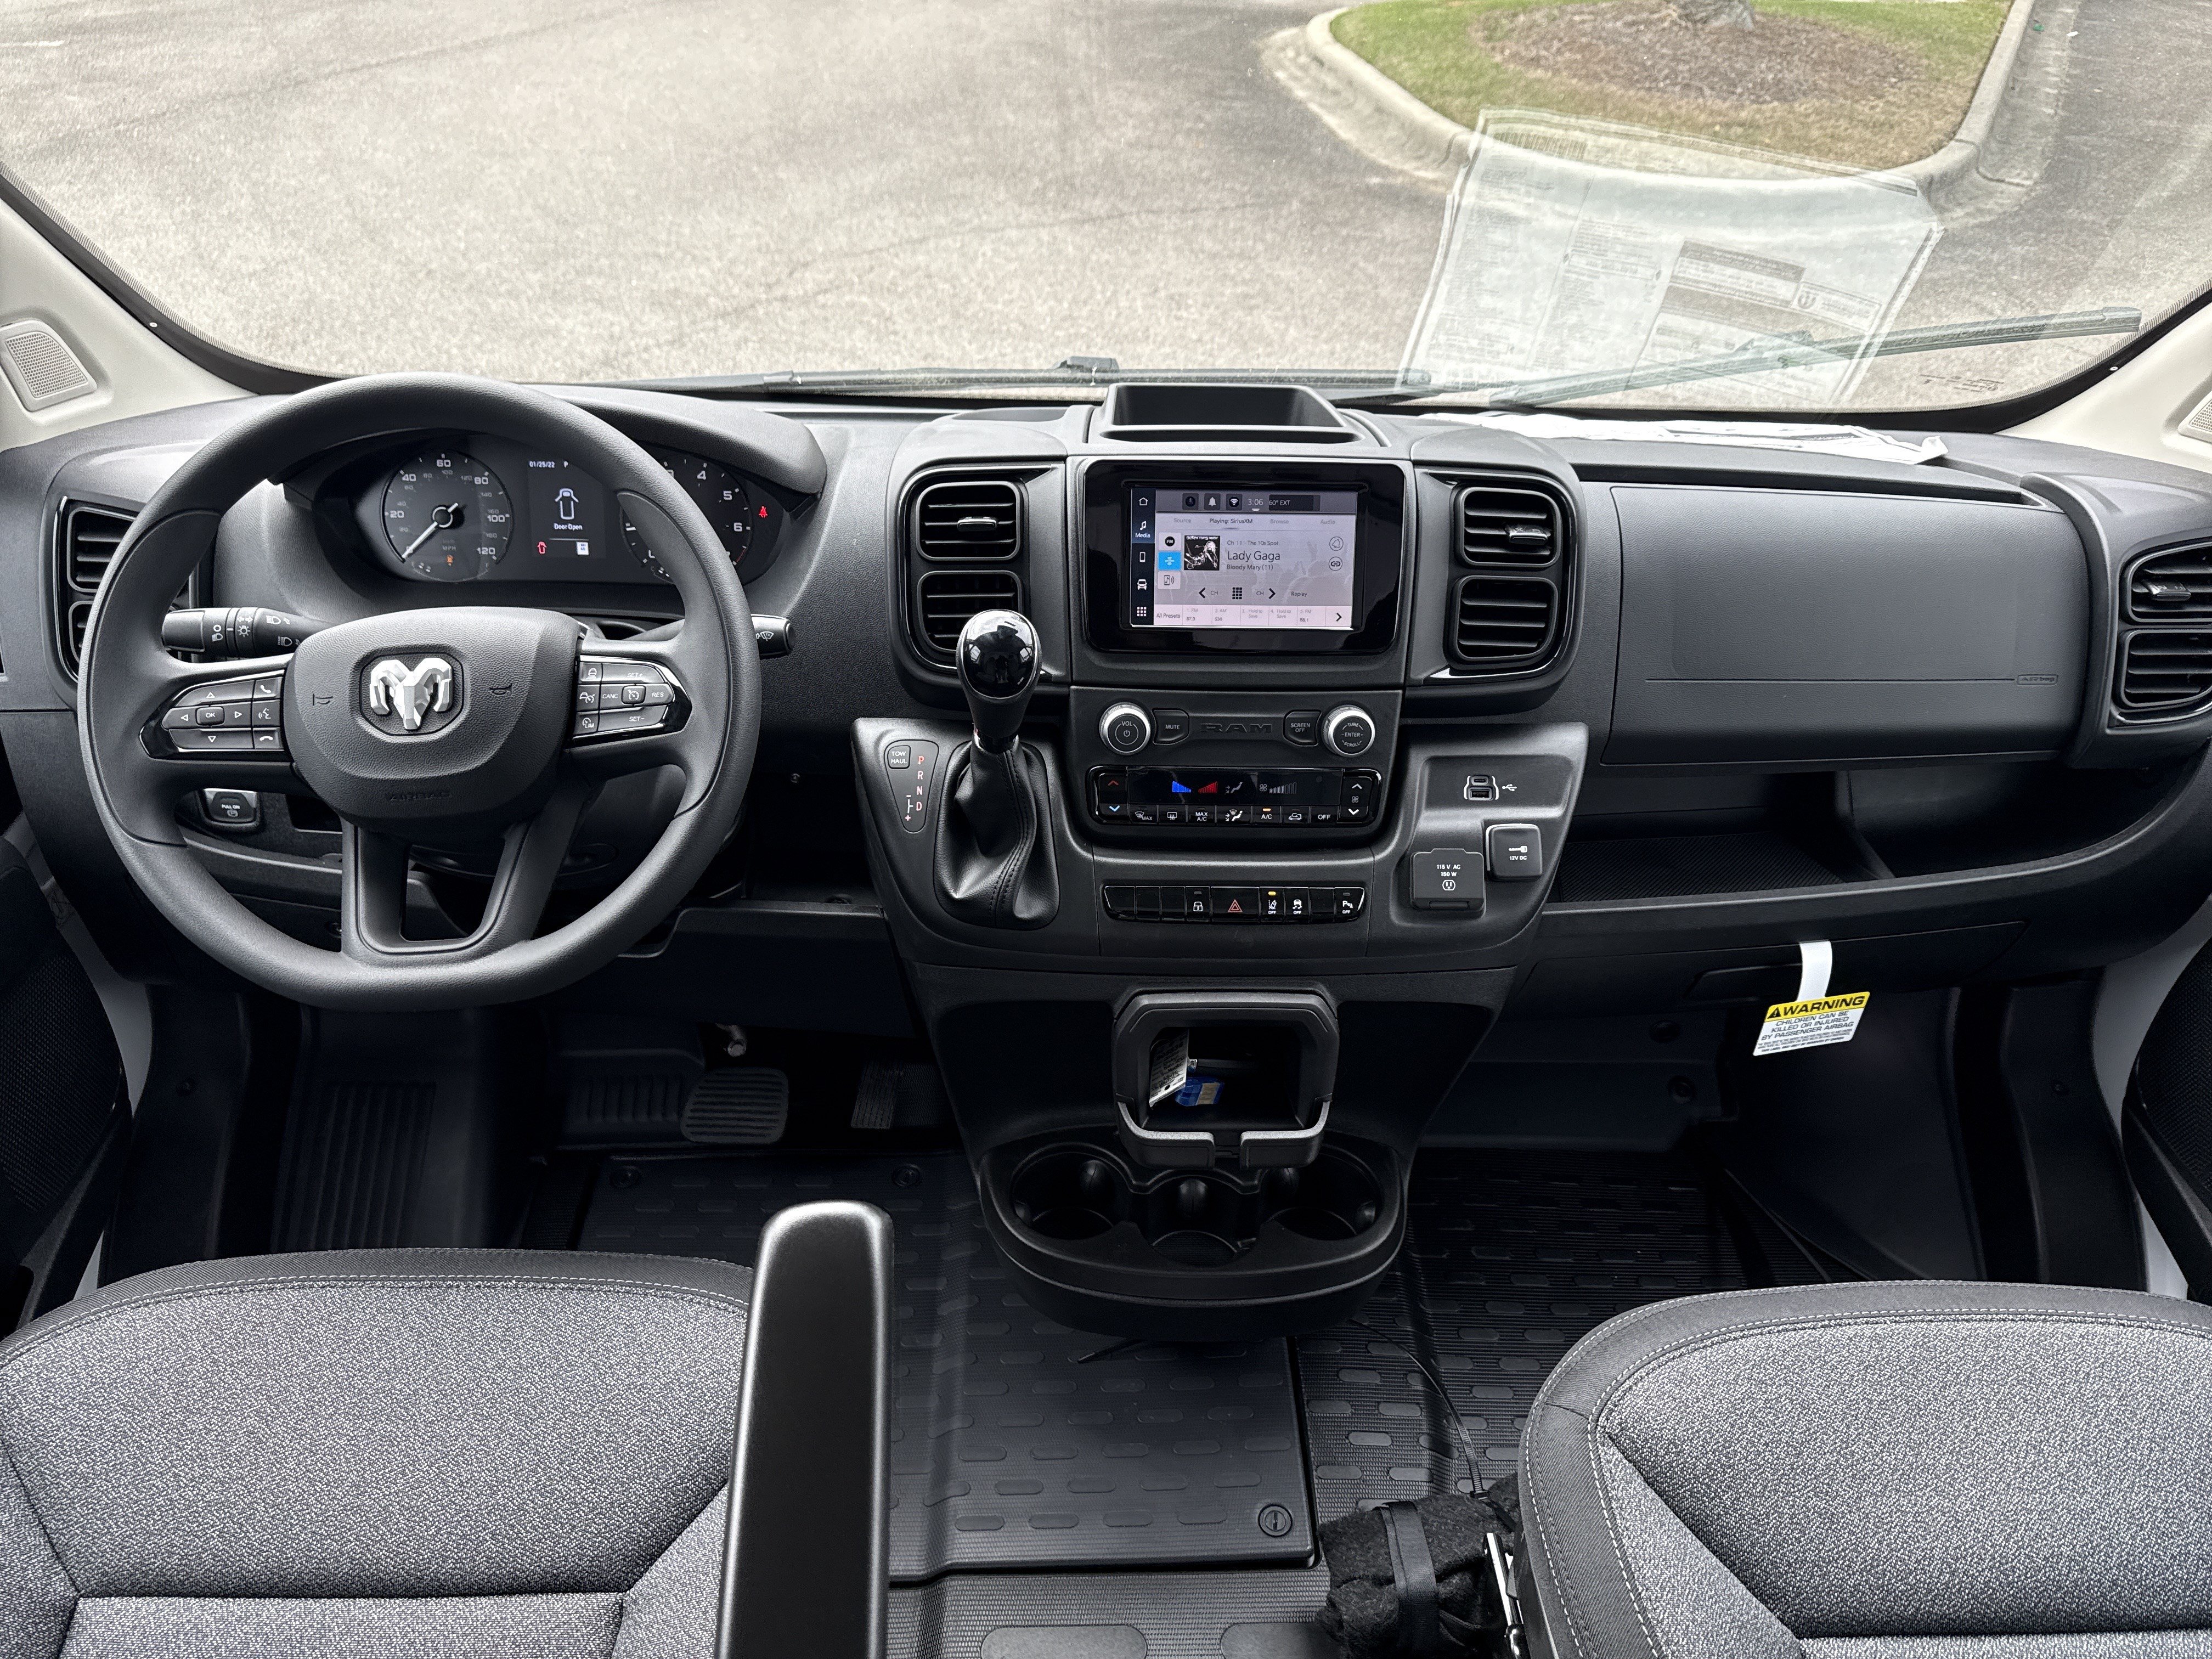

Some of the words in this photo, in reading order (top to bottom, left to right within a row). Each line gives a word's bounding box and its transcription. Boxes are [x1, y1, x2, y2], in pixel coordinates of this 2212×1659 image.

[436, 459, 451, 467] 60
[402, 473, 416, 482] 40
[697, 470, 707, 480] 4
[723, 490, 732, 500] 5
[390, 510, 404, 518] 20
[487, 515, 505, 523] 100
[733, 522, 743, 532] 6
[1227, 550, 1251, 563] Lady
[1254, 550, 1280, 563] Gaga
[1200, 723, 1272, 733] RAM
[918, 755, 925, 765] P
[917, 770, 924, 780] R
[917, 786, 923, 795] N
[916, 802, 922, 811] D
[1784, 995, 1866, 1016] WARNING
[1775, 1015, 1817, 1026] CHILDREN
[1818, 1012, 1836, 1020] CAN
[1771, 1024, 1799, 1033] KILLED
[1814, 1017, 1849, 1026] INJURED
[1774, 1026, 1822, 1039] PASSENGER
[1824, 1022, 1855, 1031] AIRBAG
